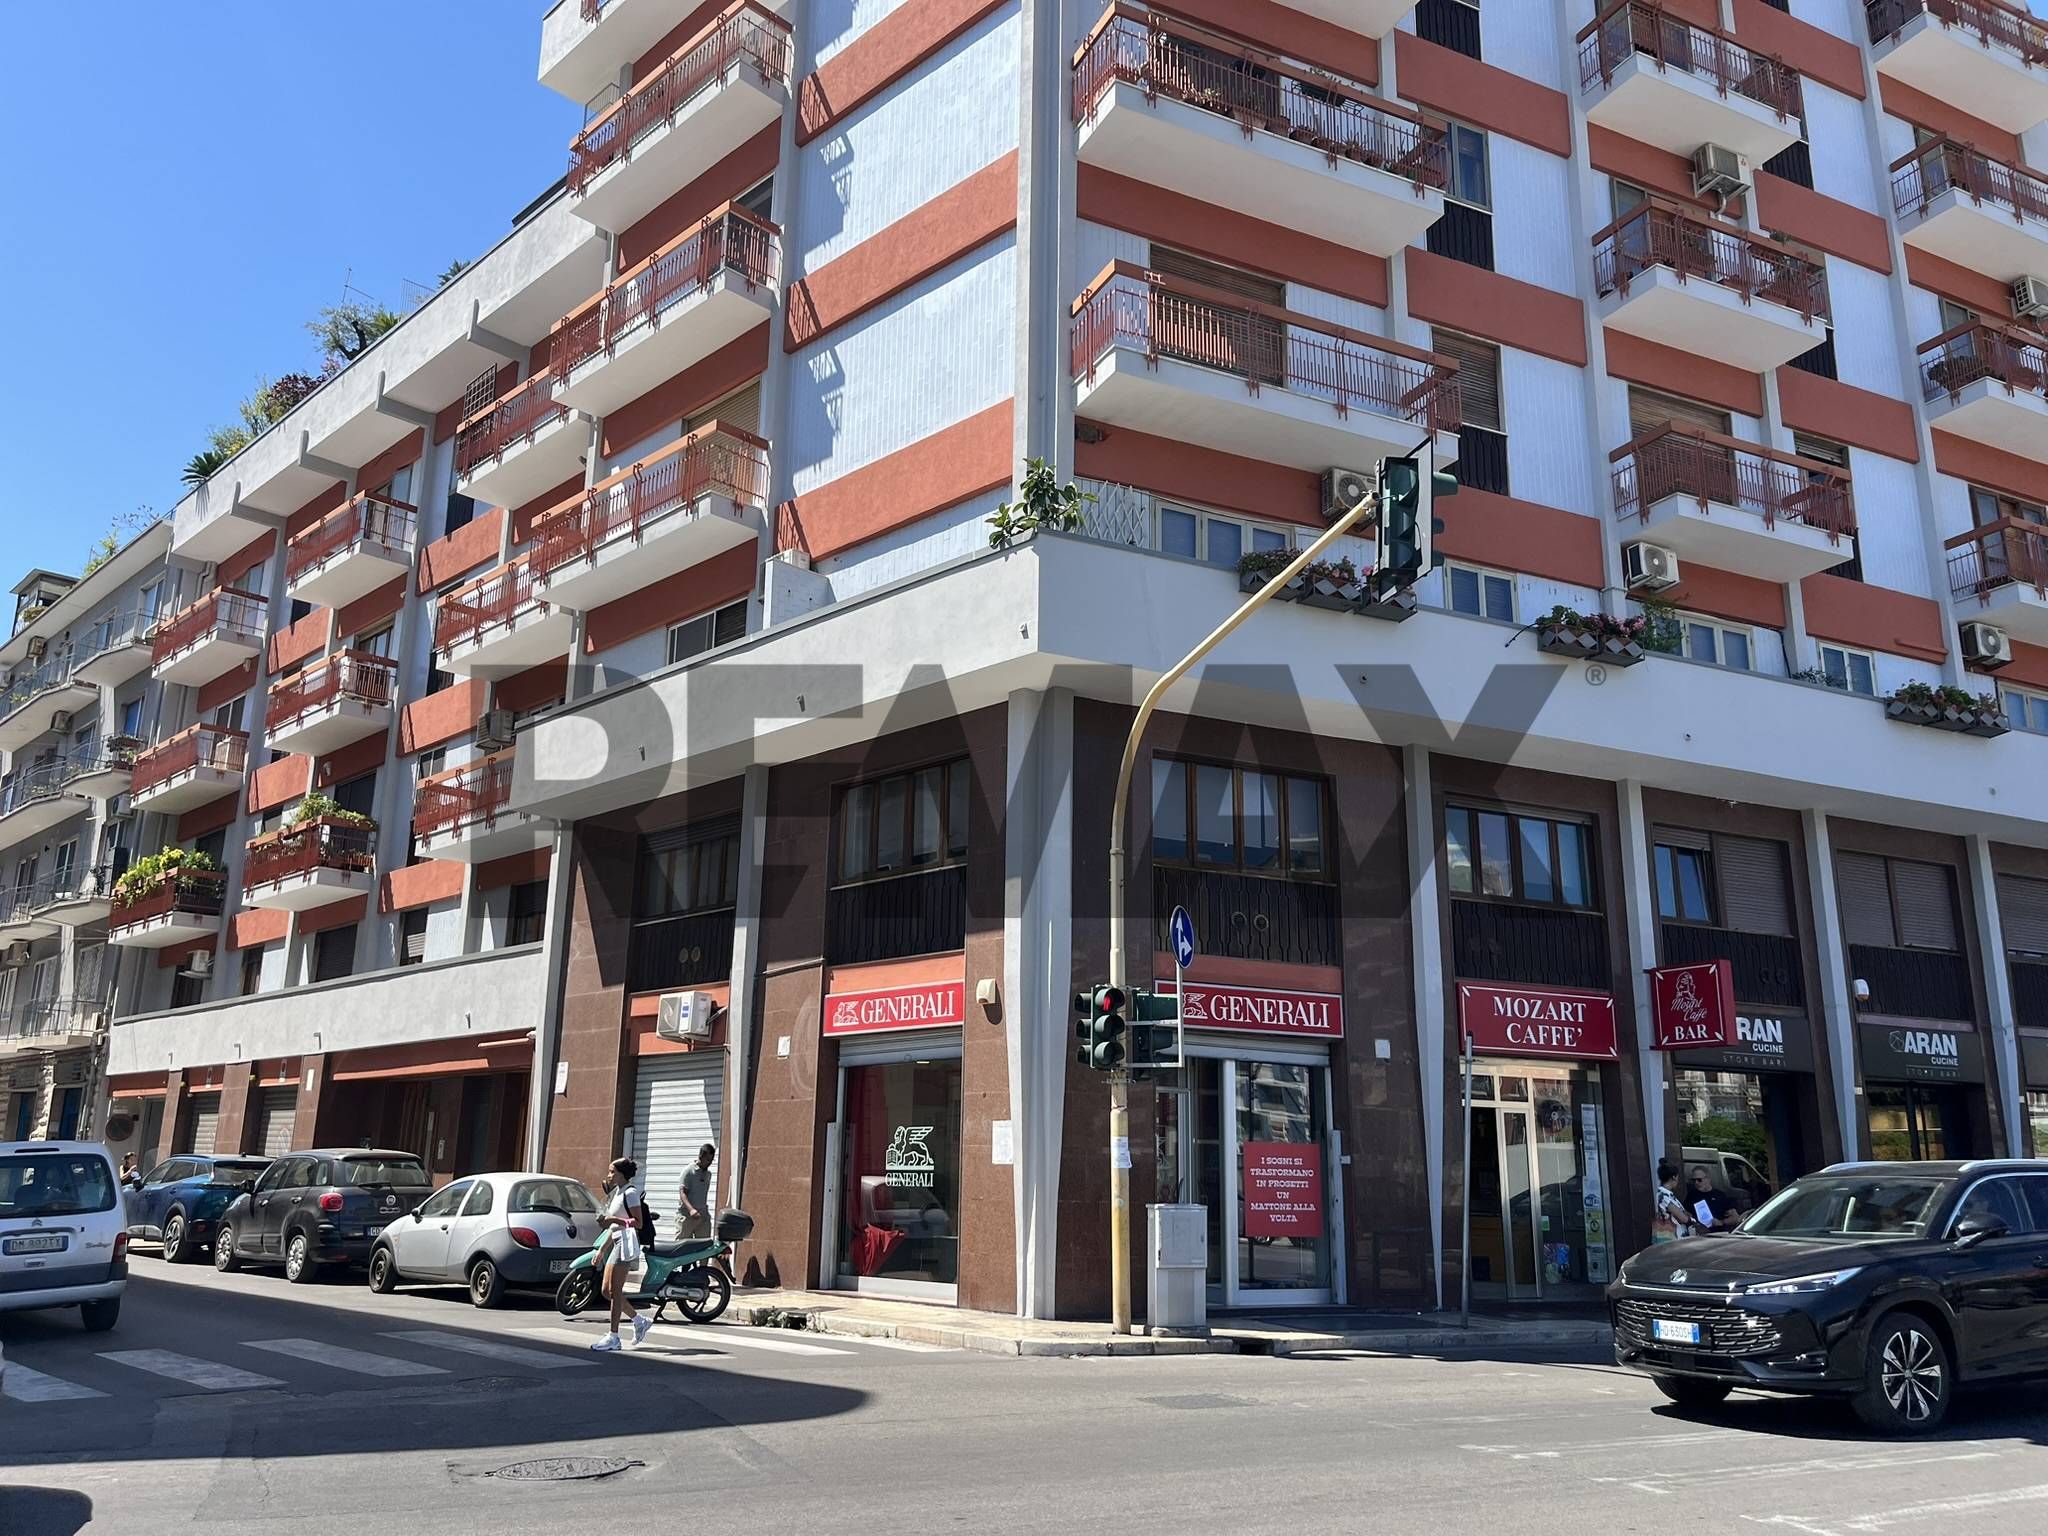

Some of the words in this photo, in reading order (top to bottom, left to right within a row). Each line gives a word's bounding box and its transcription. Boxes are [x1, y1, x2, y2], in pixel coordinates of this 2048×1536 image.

[860, 990, 955, 1025] GENERALI
[1210, 994, 1330, 1029] GENERALI
[1493, 996, 1587, 1022] MOZART
[1674, 1023, 1709, 1041] BAR
[1735, 1016, 1783, 1043] RAN
[1752, 1043, 1784, 1054] CUCINE
[1904, 1031, 1958, 1056] ARAN
[1931, 1056, 1959, 1067] CUCINE
[1266, 1157, 1293, 1165] SOGNI
[1294, 1158, 1303, 1166] SI
[885, 1172, 934, 1187] GENERALI
[1250, 1168, 1314, 1177] TRASFORMANO
[1256, 1180, 1267, 1188] IN
[1268, 1180, 1309, 1188] PROGETTI
[1250, 1203, 1292, 1211] MATTONE
[1293, 1203, 1316, 1211] ALLA
